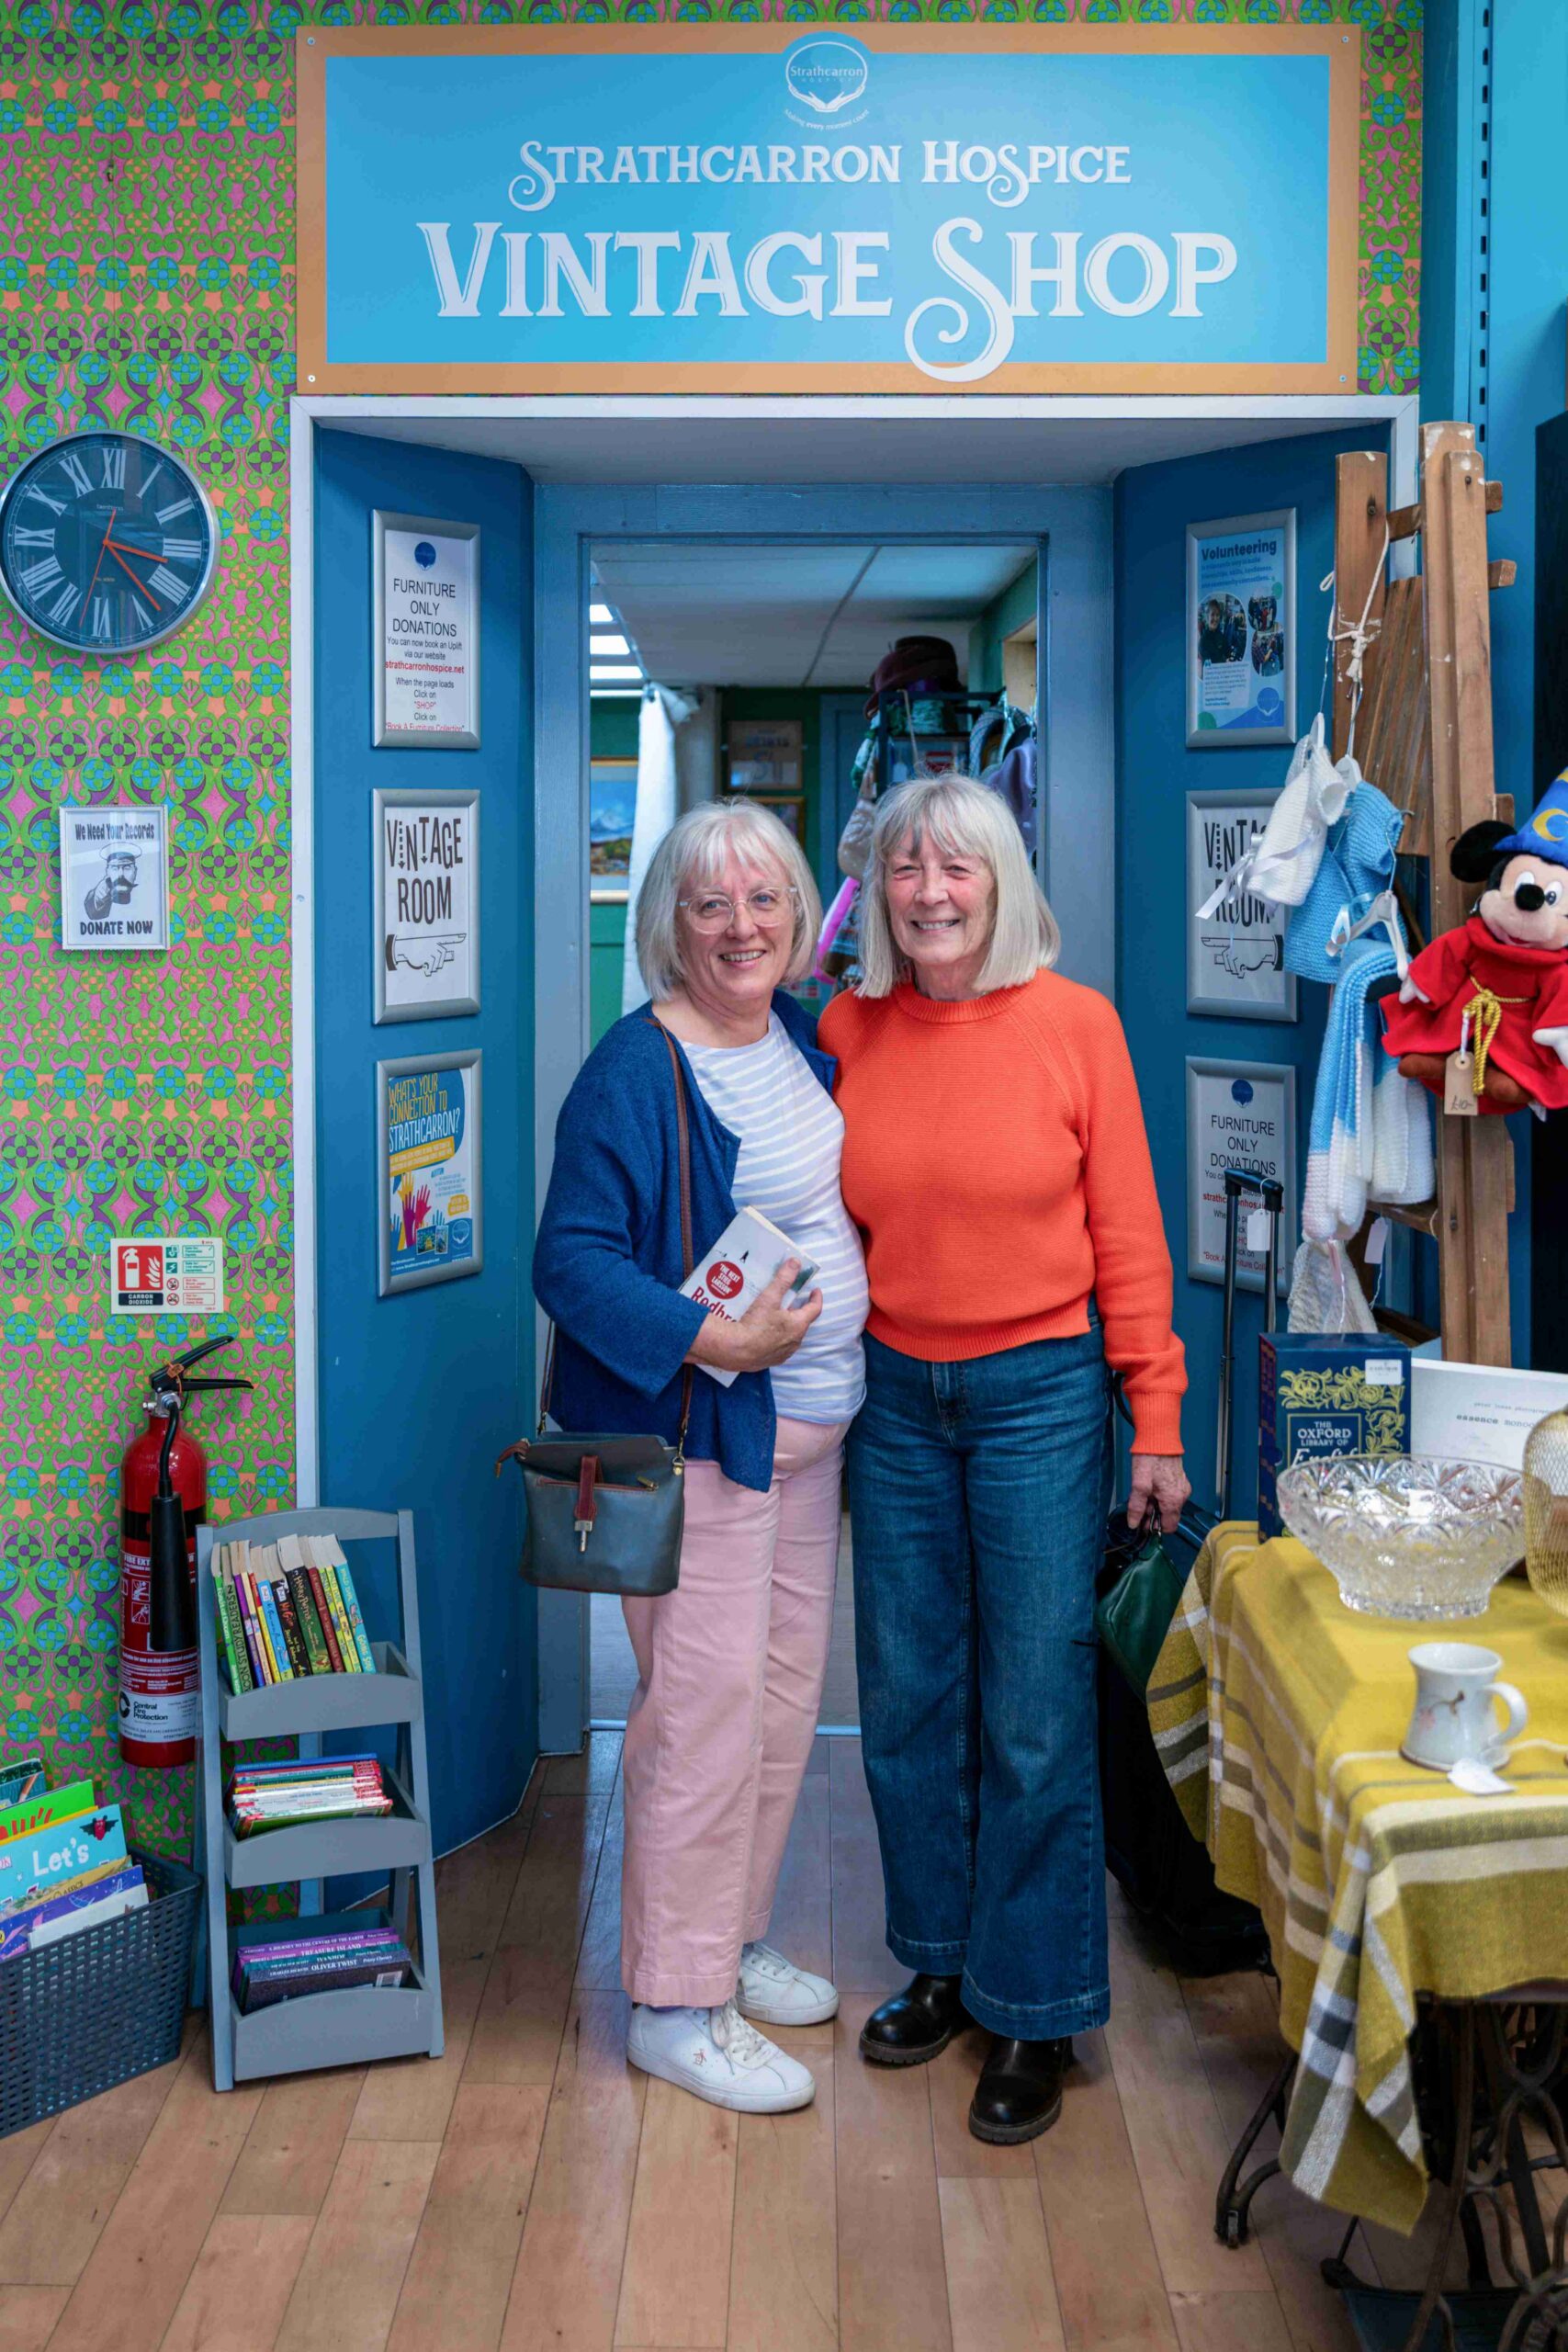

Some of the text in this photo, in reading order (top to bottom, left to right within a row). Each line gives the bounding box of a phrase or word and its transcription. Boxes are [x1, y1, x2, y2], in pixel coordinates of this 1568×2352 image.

[790, 65, 863, 77] Strathcarron
[508, 141, 1132, 212] STRATHCARRON HOSPICE
[416, 217, 1238, 383] VINTAGE SHOP
[1201, 539, 1277, 560] Volunteering
[393, 578, 456, 598] FURNITURE
[411, 600, 440, 616] ONLY
[393, 618, 457, 637] DONATIONS
[388, 636, 399, 645] You
[424, 639, 439, 649] book
[424, 651, 446, 660] website
[385, 660, 465, 674] strathcarronhospice.net
[395, 677, 454, 689] When the page loads
[413, 689, 427, 698] Click
[413, 712, 427, 721] Click
[75, 823, 154, 841] We Need Your Records
[1204, 820, 1268, 872] VINT
[398, 876, 452, 925] ROOM
[80, 921, 153, 935] DONATE NOW
[389, 1073, 438, 1106] WHAT'S YOUR
[389, 1090, 447, 1125] CONNECTION TO
[389, 1107, 460, 1153] STRATHCARRON?
[1211, 1115, 1275, 1136] FURNITURE
[1227, 1136, 1258, 1153] ONLY
[1211, 1153, 1276, 1176] DONATIONS
[1205, 1170, 1216, 1179] You
[1213, 1209, 1227, 1219] Whe
[718, 1272, 731, 1286] STIEG
[728, 1270, 740, 1283] NEXT
[1456, 1413, 1499, 1424] essence
[1297, 1428, 1352, 1439] OXFORD
[294, 1575, 311, 1622] HARRY POTTER
[227, 1595, 242, 1634] READERS
[233, 1635, 247, 1667] STUDY
[32, 1837, 90, 1878] Let's
[301, 1943, 362, 1956] TREASURE ISLAND
[317, 1953, 345, 1962] IVANHOE
[311, 1959, 357, 1971] OLIVER TWIST
